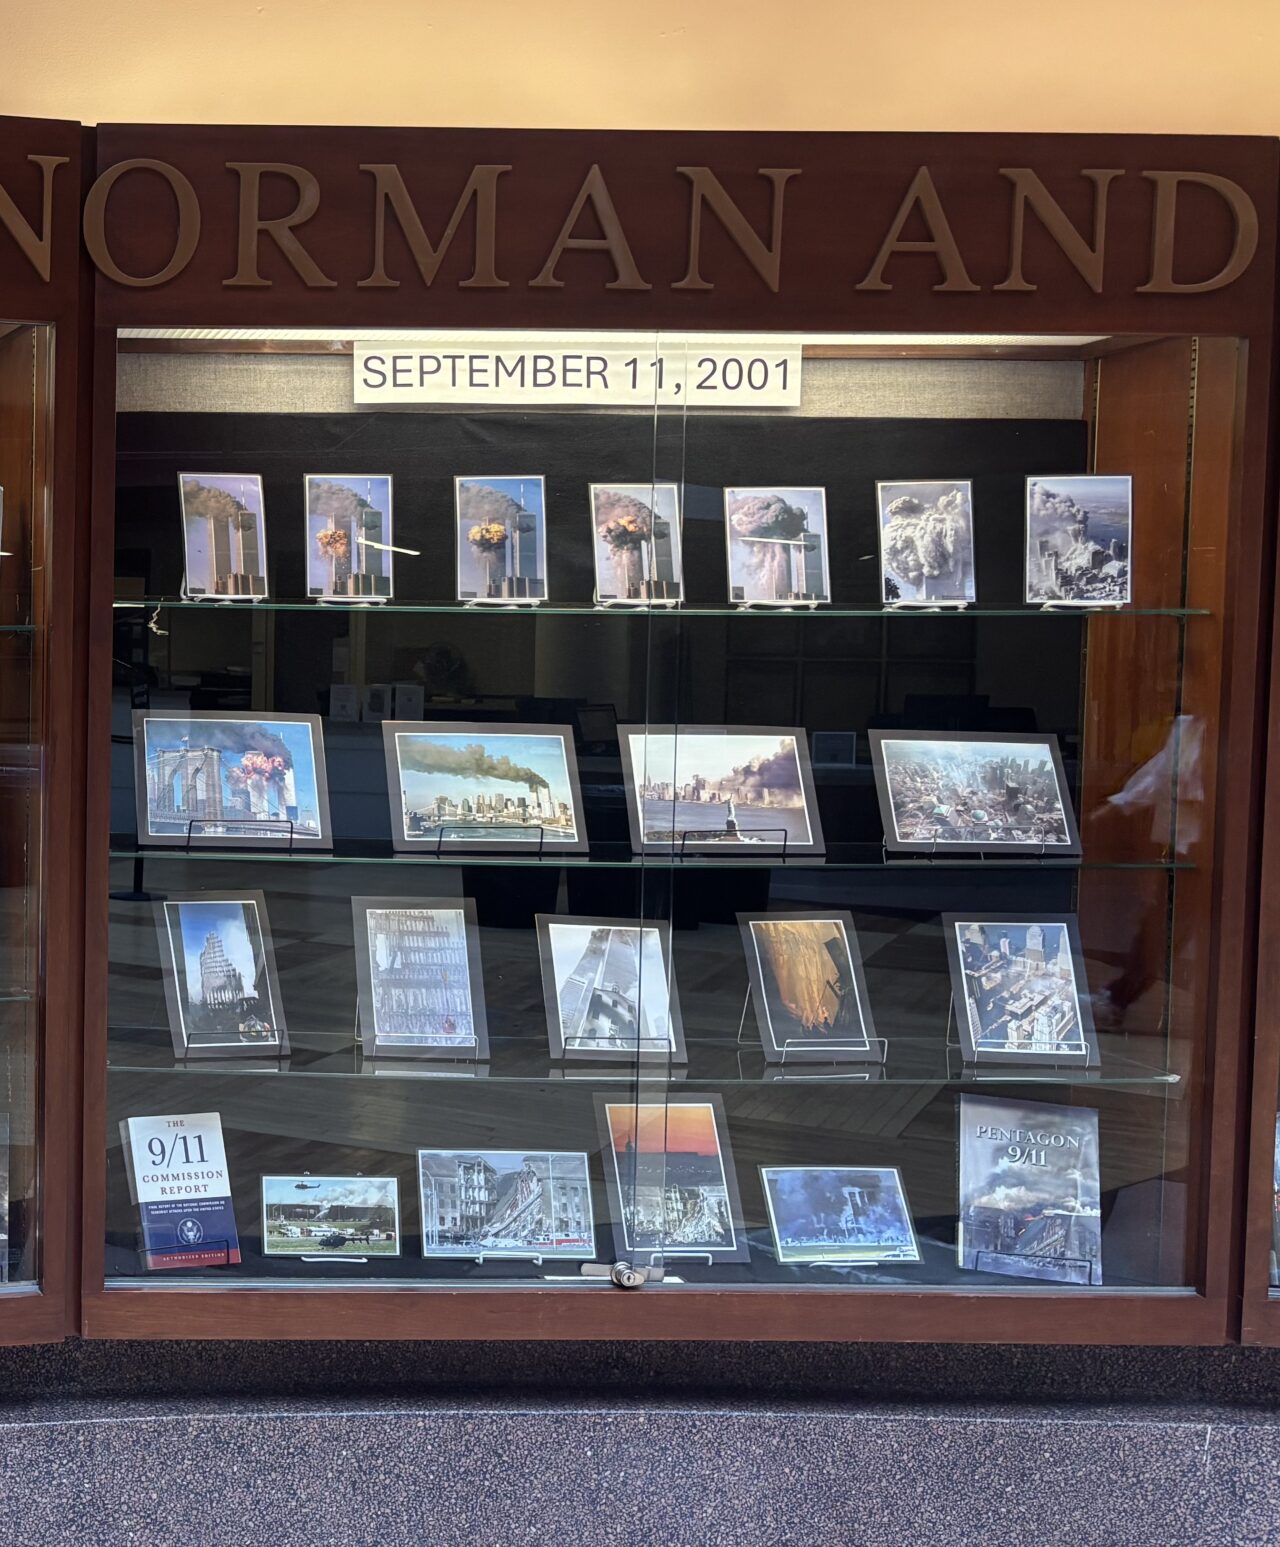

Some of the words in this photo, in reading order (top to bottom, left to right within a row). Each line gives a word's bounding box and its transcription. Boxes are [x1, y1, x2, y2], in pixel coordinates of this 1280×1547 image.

[855, 165, 1259, 293] AND
[362, 354, 609, 390] SEPTEMBER
[624, 358, 683, 396] 11,
[696, 358, 790, 391] 2001
[976, 1125, 1081, 1149] PENTAGON
[148, 1133, 209, 1168] 9/11
[1008, 1146, 1048, 1167] 9/11
[142, 1170, 223, 1183] COMMISSION
[160, 1184, 209, 1195] REPORT
